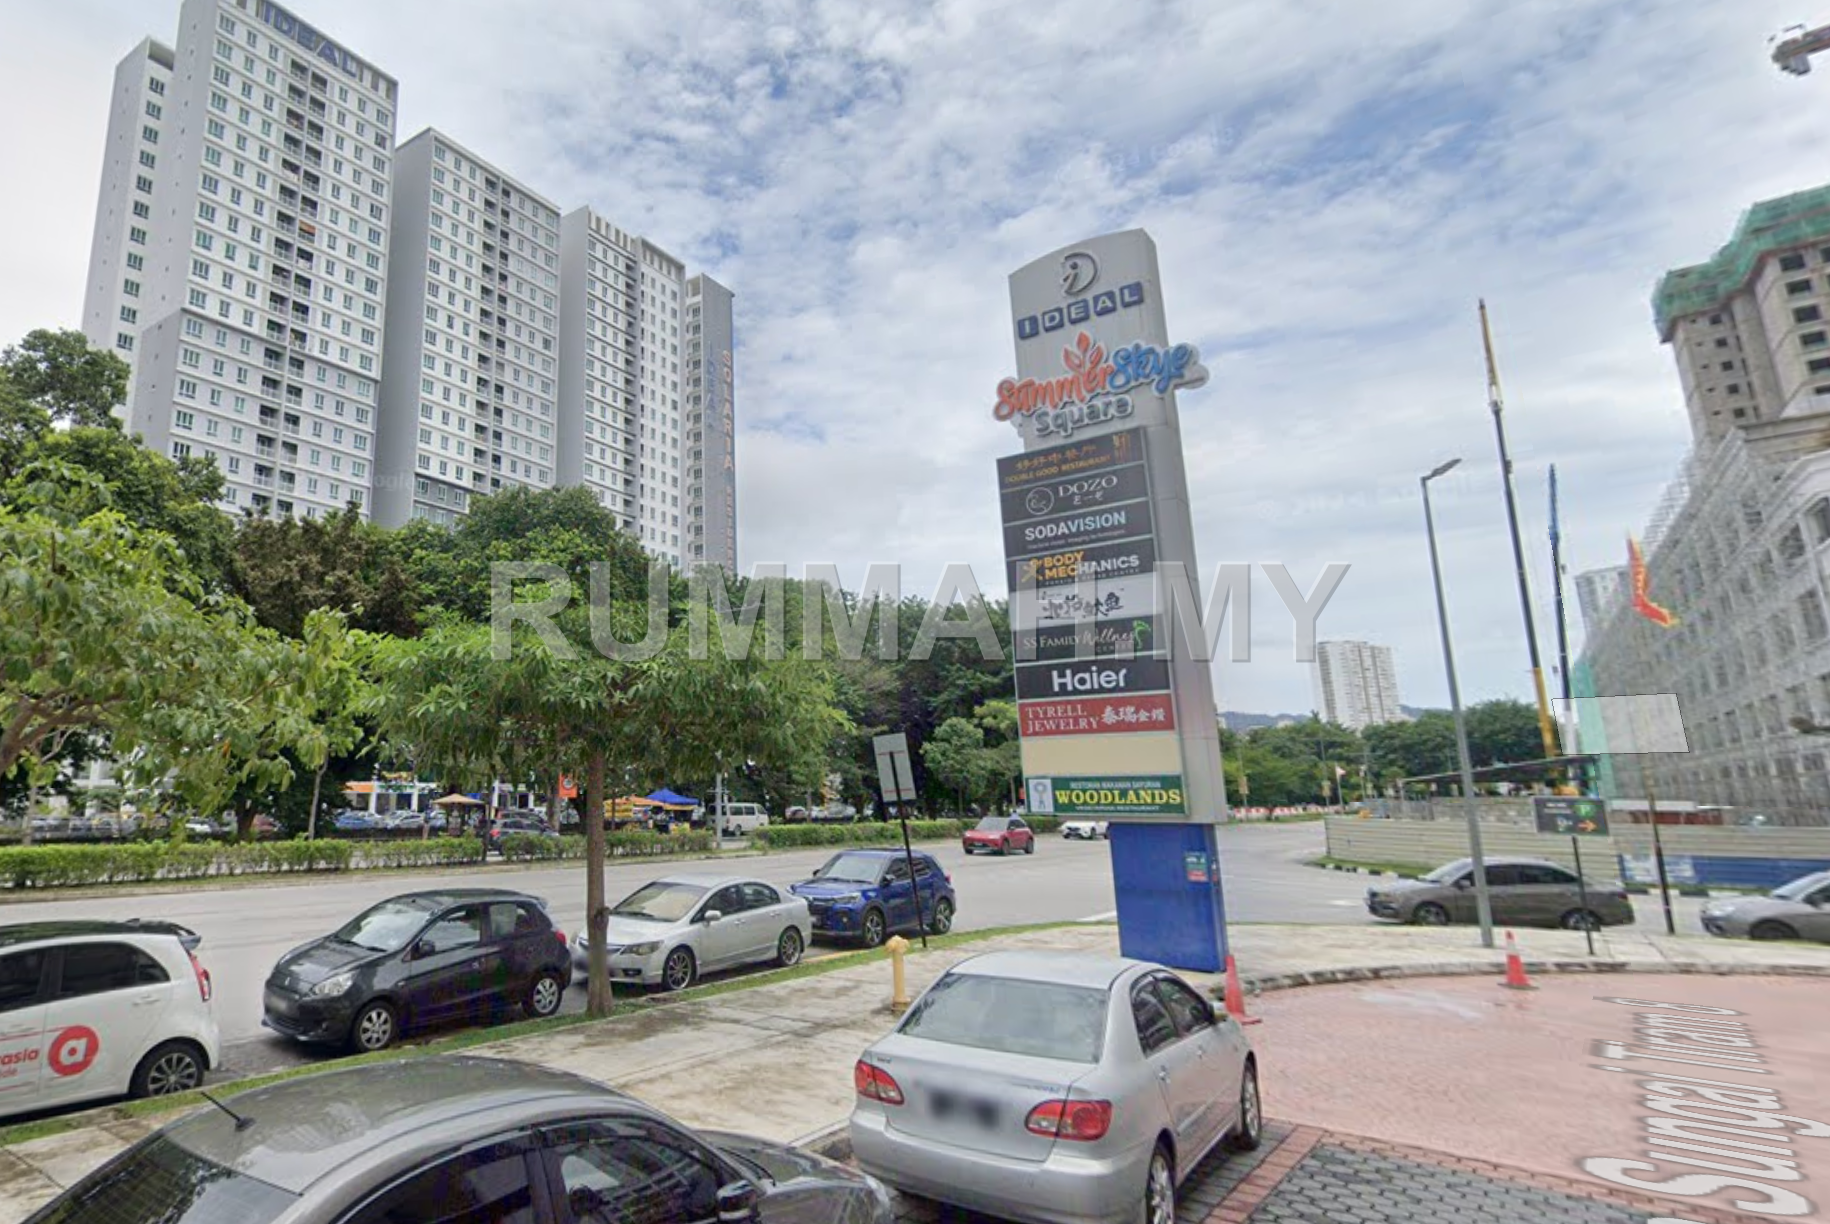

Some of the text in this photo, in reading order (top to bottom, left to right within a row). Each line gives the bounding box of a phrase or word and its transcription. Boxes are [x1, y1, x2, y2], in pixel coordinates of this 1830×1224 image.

[1021, 284, 1141, 337] IDEAL
[1034, 396, 1131, 435] Square
[1058, 474, 1118, 497] DOZO
[1025, 510, 1126, 541] SODAVISION
[1044, 551, 1084, 568] BODY
[1045, 554, 1139, 580] MECHANICS
[1040, 634, 1079, 649] FAMILY
[1051, 665, 1127, 692] Haier
[1025, 704, 1087, 719] TYRELL
[1026, 716, 1100, 734] JEWELRY
[1055, 788, 1181, 804] WOODLANDS
[0, 1047, 39, 1066] asia
